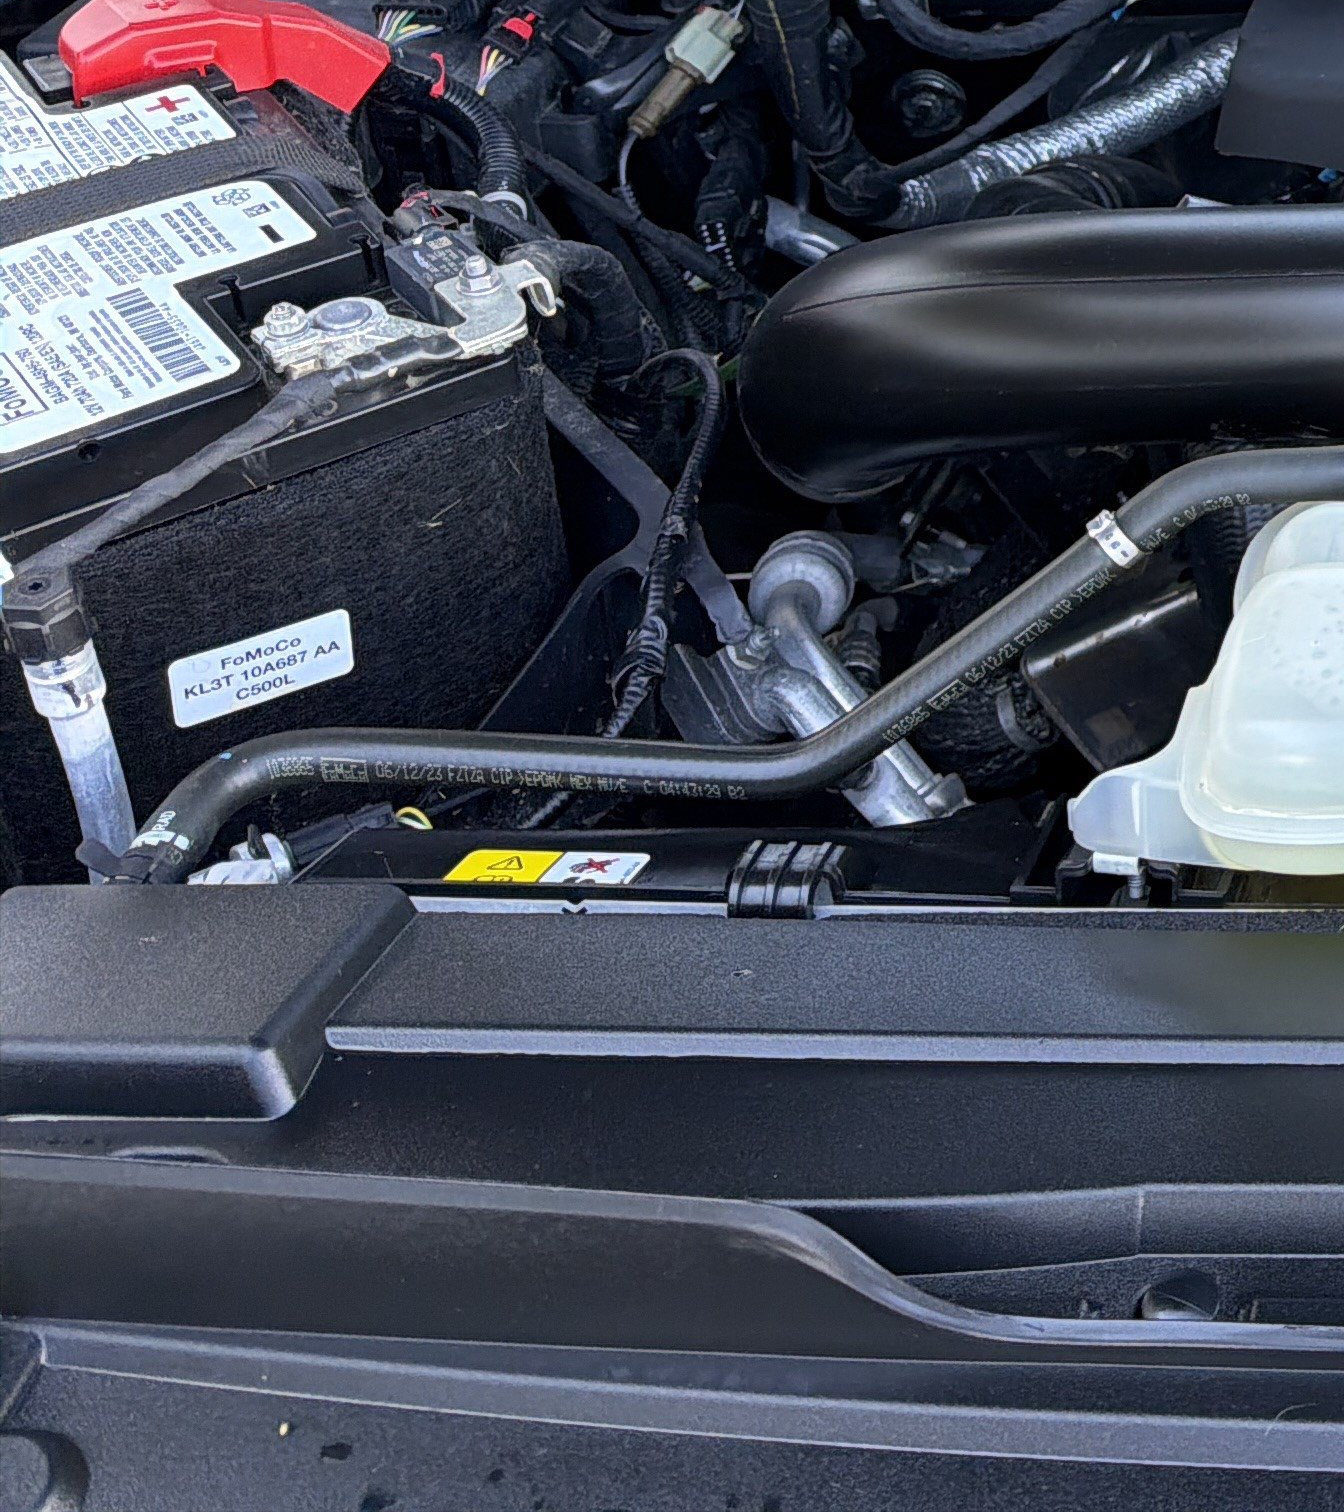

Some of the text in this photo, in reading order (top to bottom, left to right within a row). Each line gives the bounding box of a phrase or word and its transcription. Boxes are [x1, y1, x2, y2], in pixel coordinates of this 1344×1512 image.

[220, 637, 302, 671] FoMoCo
[183, 640, 341, 700] KL3T 10A687 AA
[235, 673, 296, 701] C500L
[375, 760, 443, 782] 06/12/23
